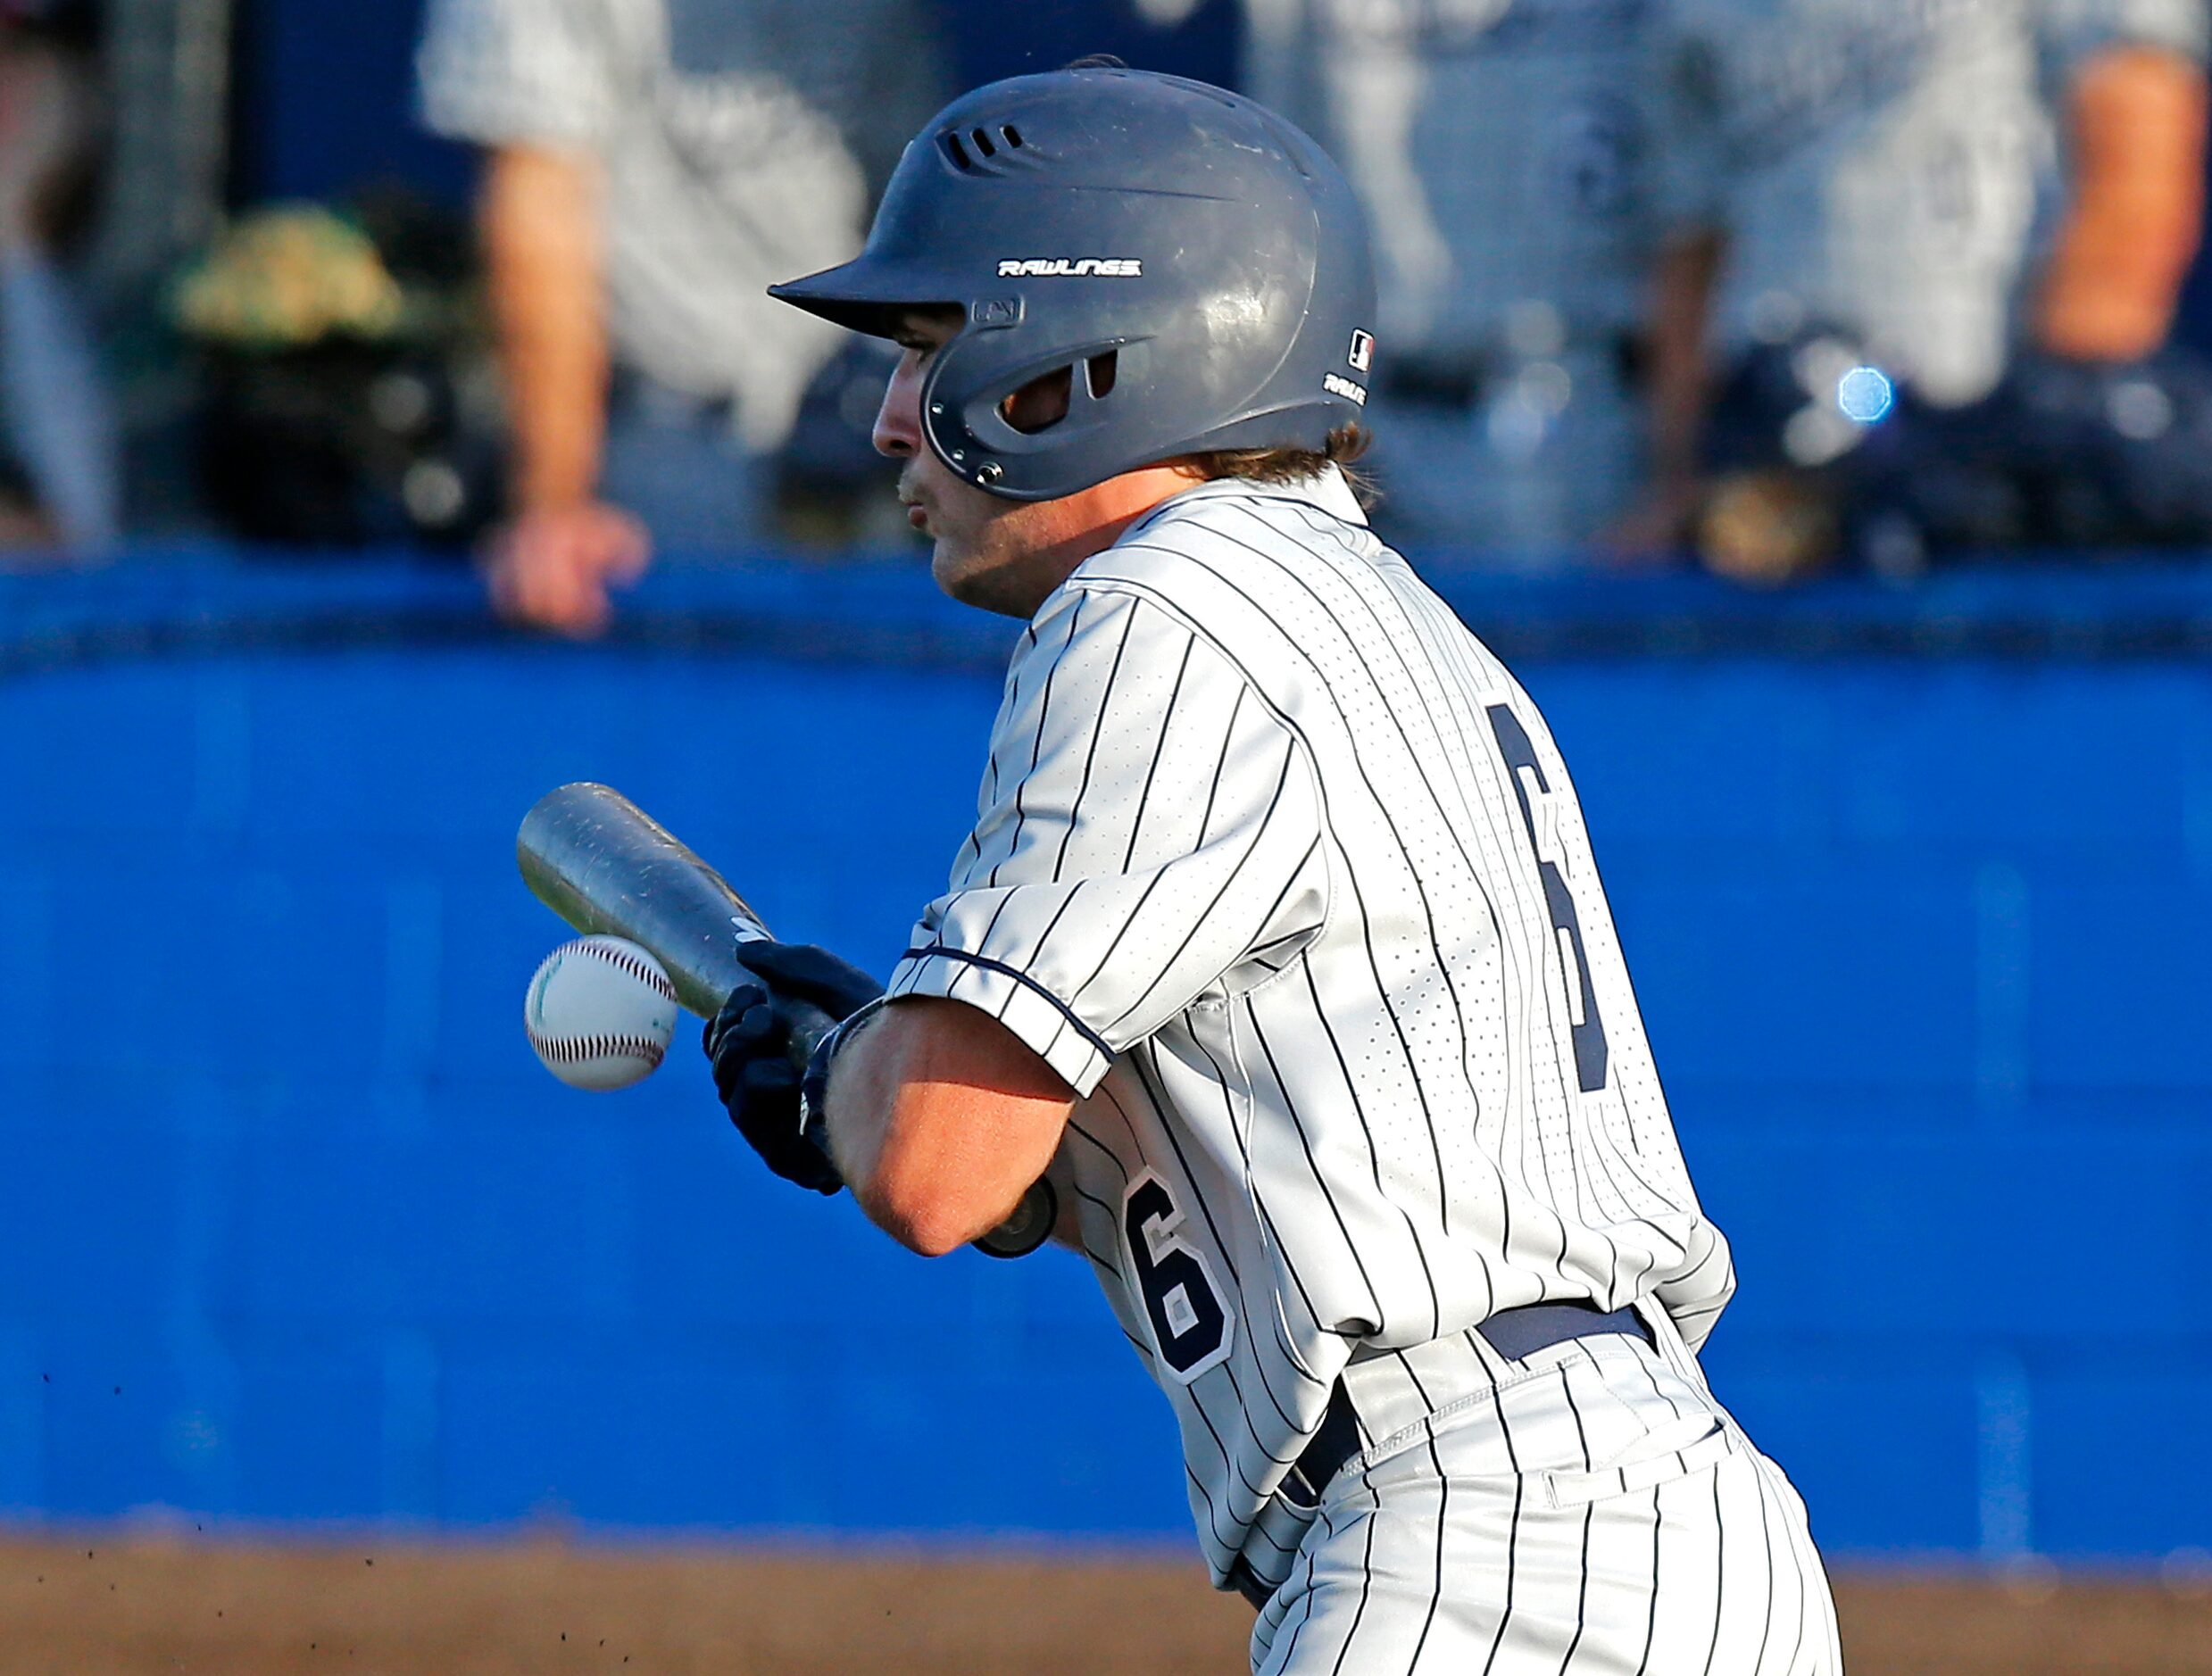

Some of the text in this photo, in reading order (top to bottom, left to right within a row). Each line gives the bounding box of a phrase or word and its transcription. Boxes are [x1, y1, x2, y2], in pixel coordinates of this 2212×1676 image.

[997, 258, 1143, 278] RAWLINGS
[1485, 702, 1608, 1093] 6
[1123, 1166, 1235, 1385] 6
